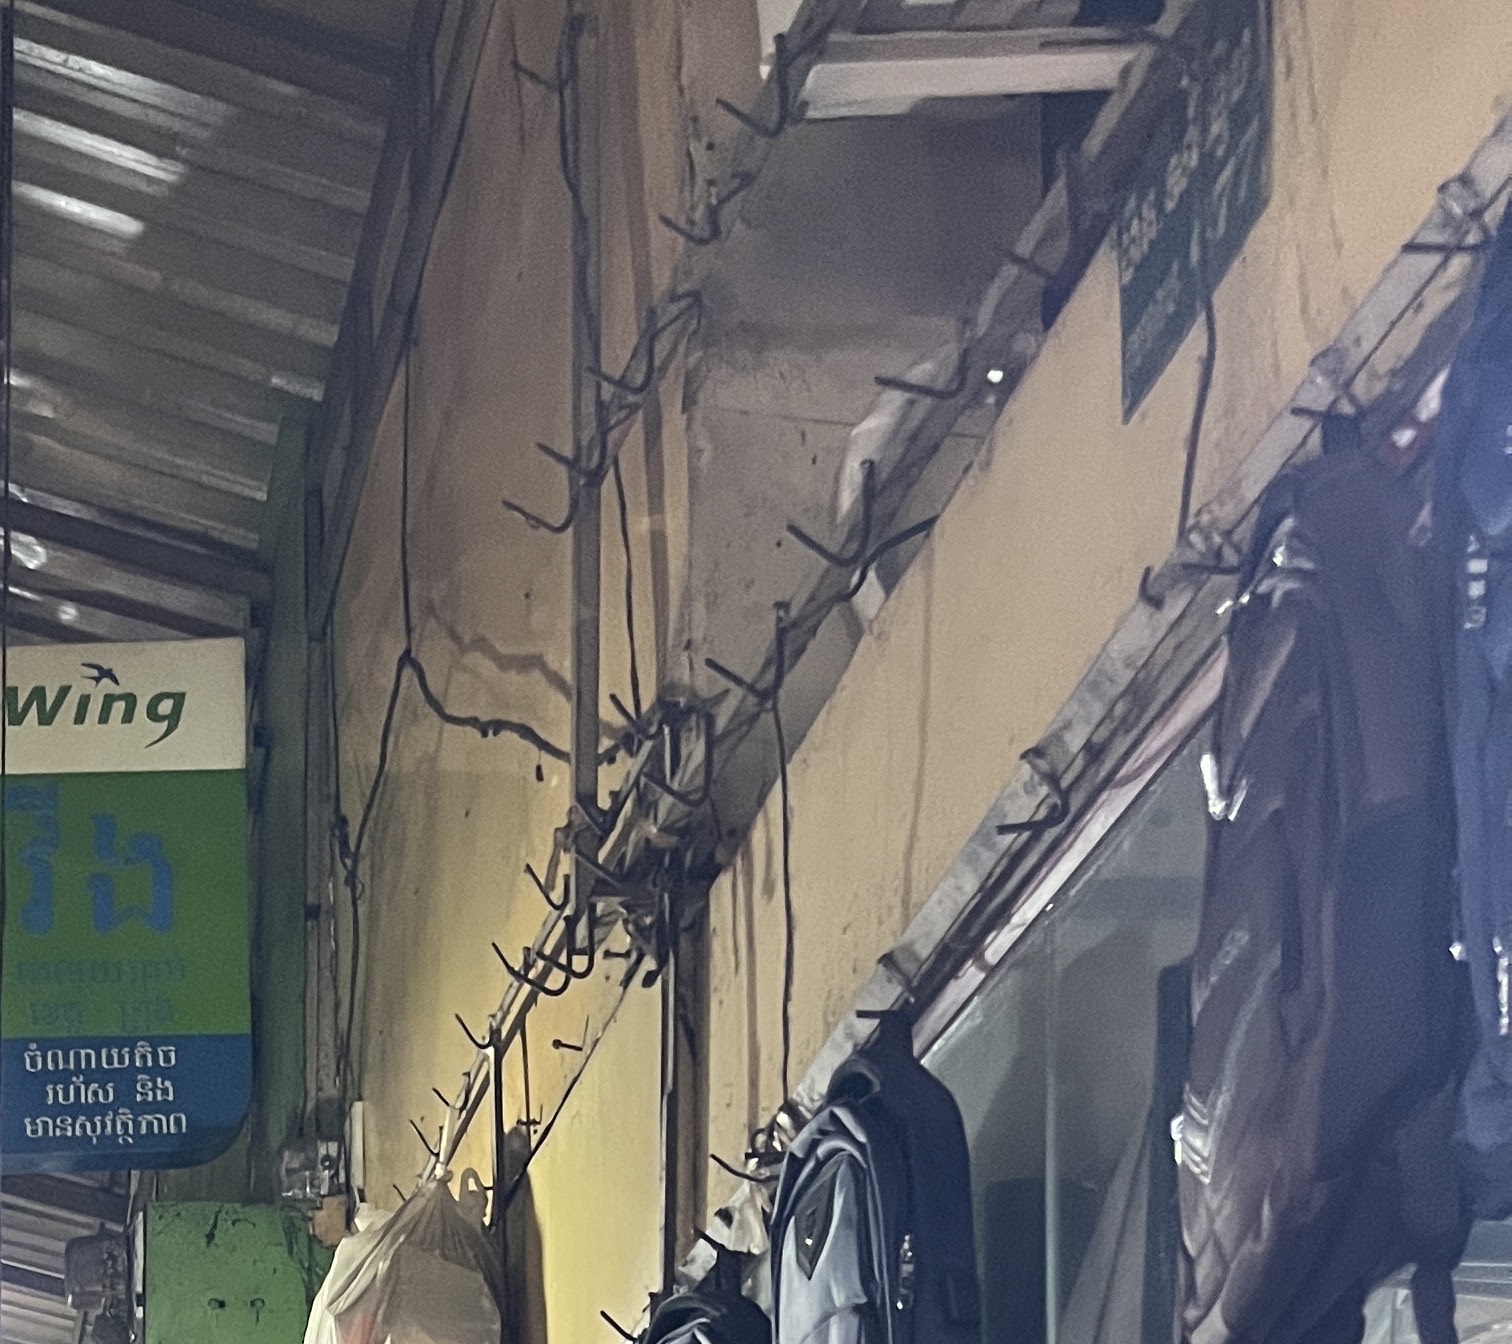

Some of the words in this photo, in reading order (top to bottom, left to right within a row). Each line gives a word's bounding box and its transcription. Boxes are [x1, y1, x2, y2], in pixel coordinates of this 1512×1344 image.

[4, 684, 187, 748] Wing
[24, 1041, 177, 1072] ចំណាយតិច
[136, 1074, 174, 1102] និង
